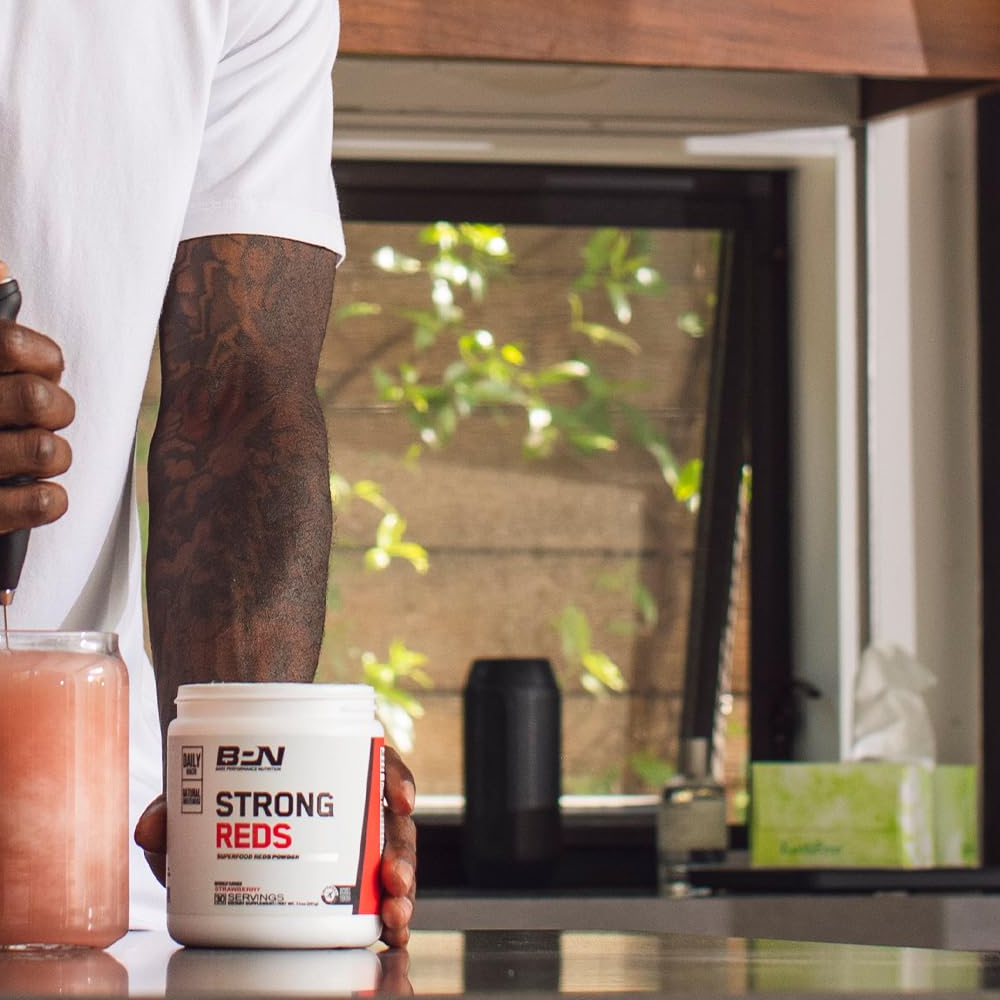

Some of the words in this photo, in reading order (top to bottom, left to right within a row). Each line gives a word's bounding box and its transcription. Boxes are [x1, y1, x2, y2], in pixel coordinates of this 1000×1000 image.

[216, 791, 334, 817] STRONG
[216, 823, 292, 849] REDS
[228, 893, 284, 901] SERVINGS
